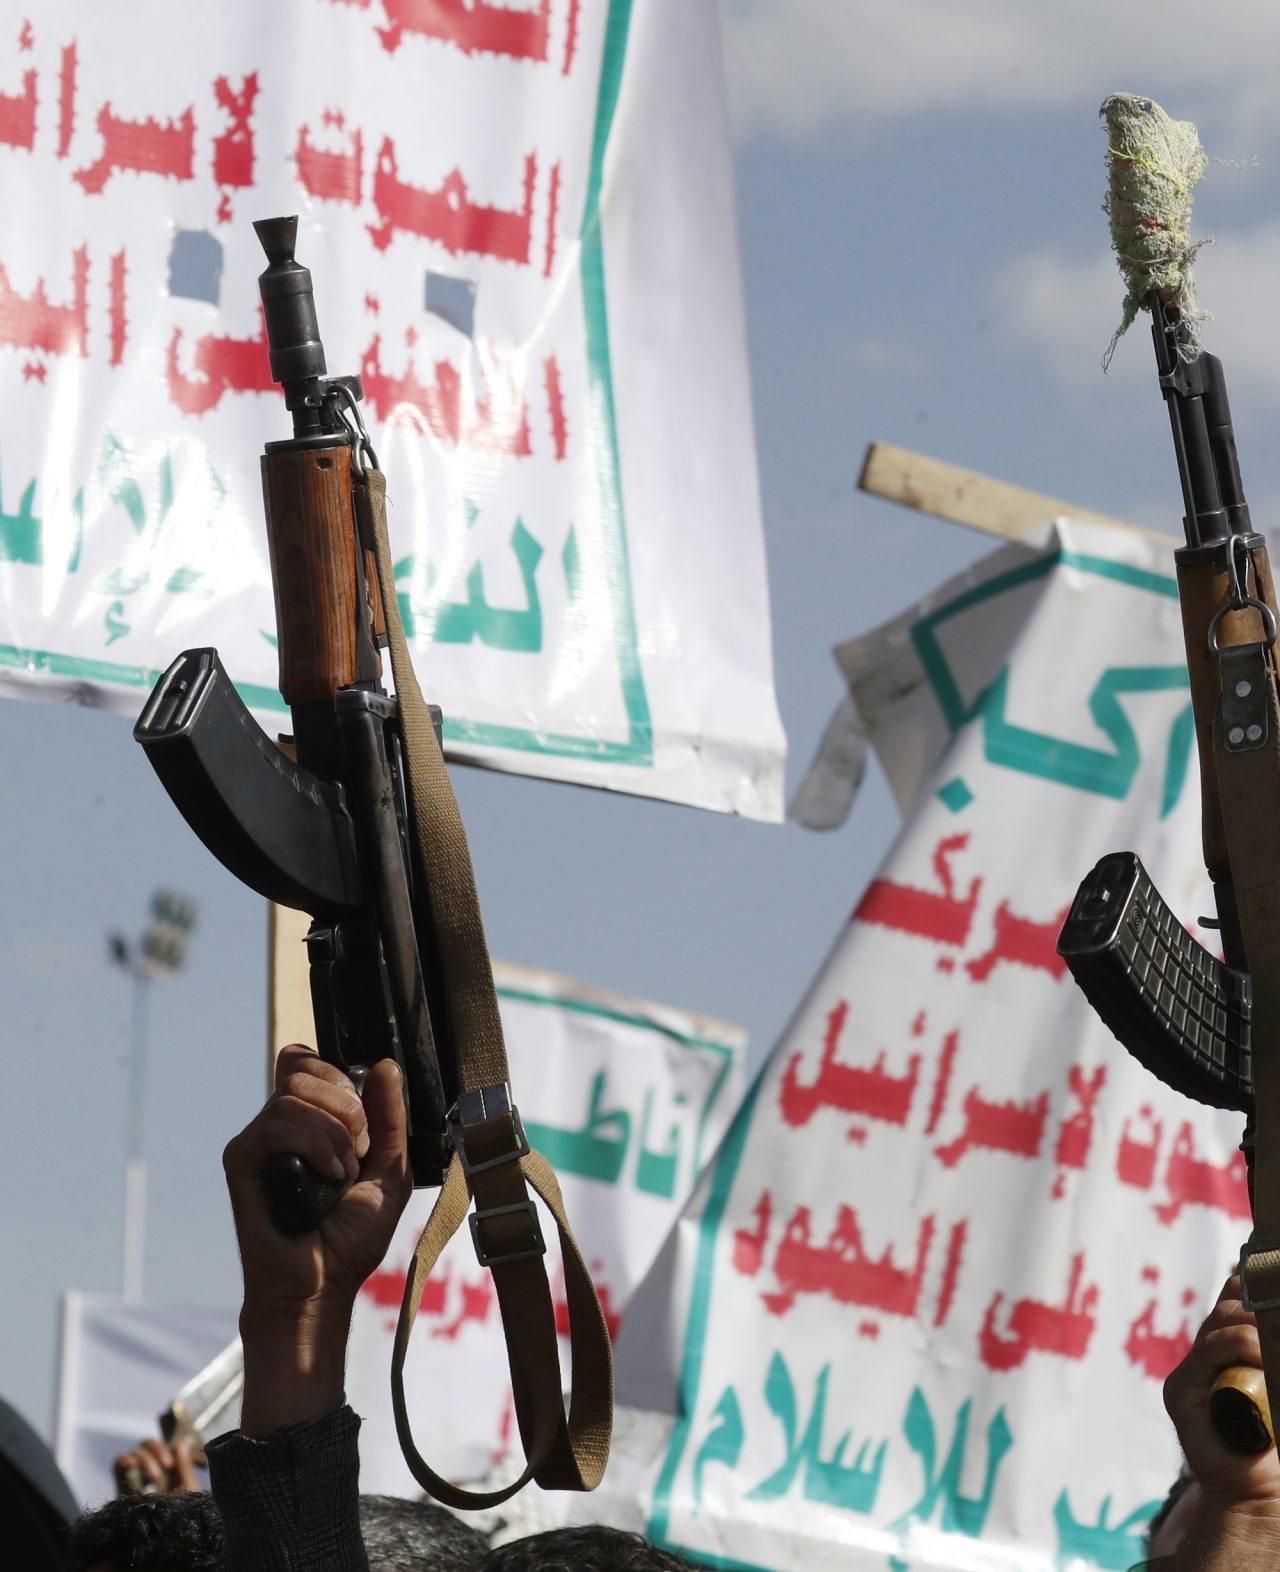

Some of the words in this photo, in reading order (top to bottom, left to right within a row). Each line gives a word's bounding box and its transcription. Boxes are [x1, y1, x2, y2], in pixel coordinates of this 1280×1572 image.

[295, 107, 562, 279] الموت
[778, 999, 1107, 1200] لإسرائيل
[1116, 1102, 1254, 1228] موت
[732, 1189, 970, 1342] اليهود
[978, 1253, 1101, 1372] على
[690, 1349, 1013, 1572] للإسلام
